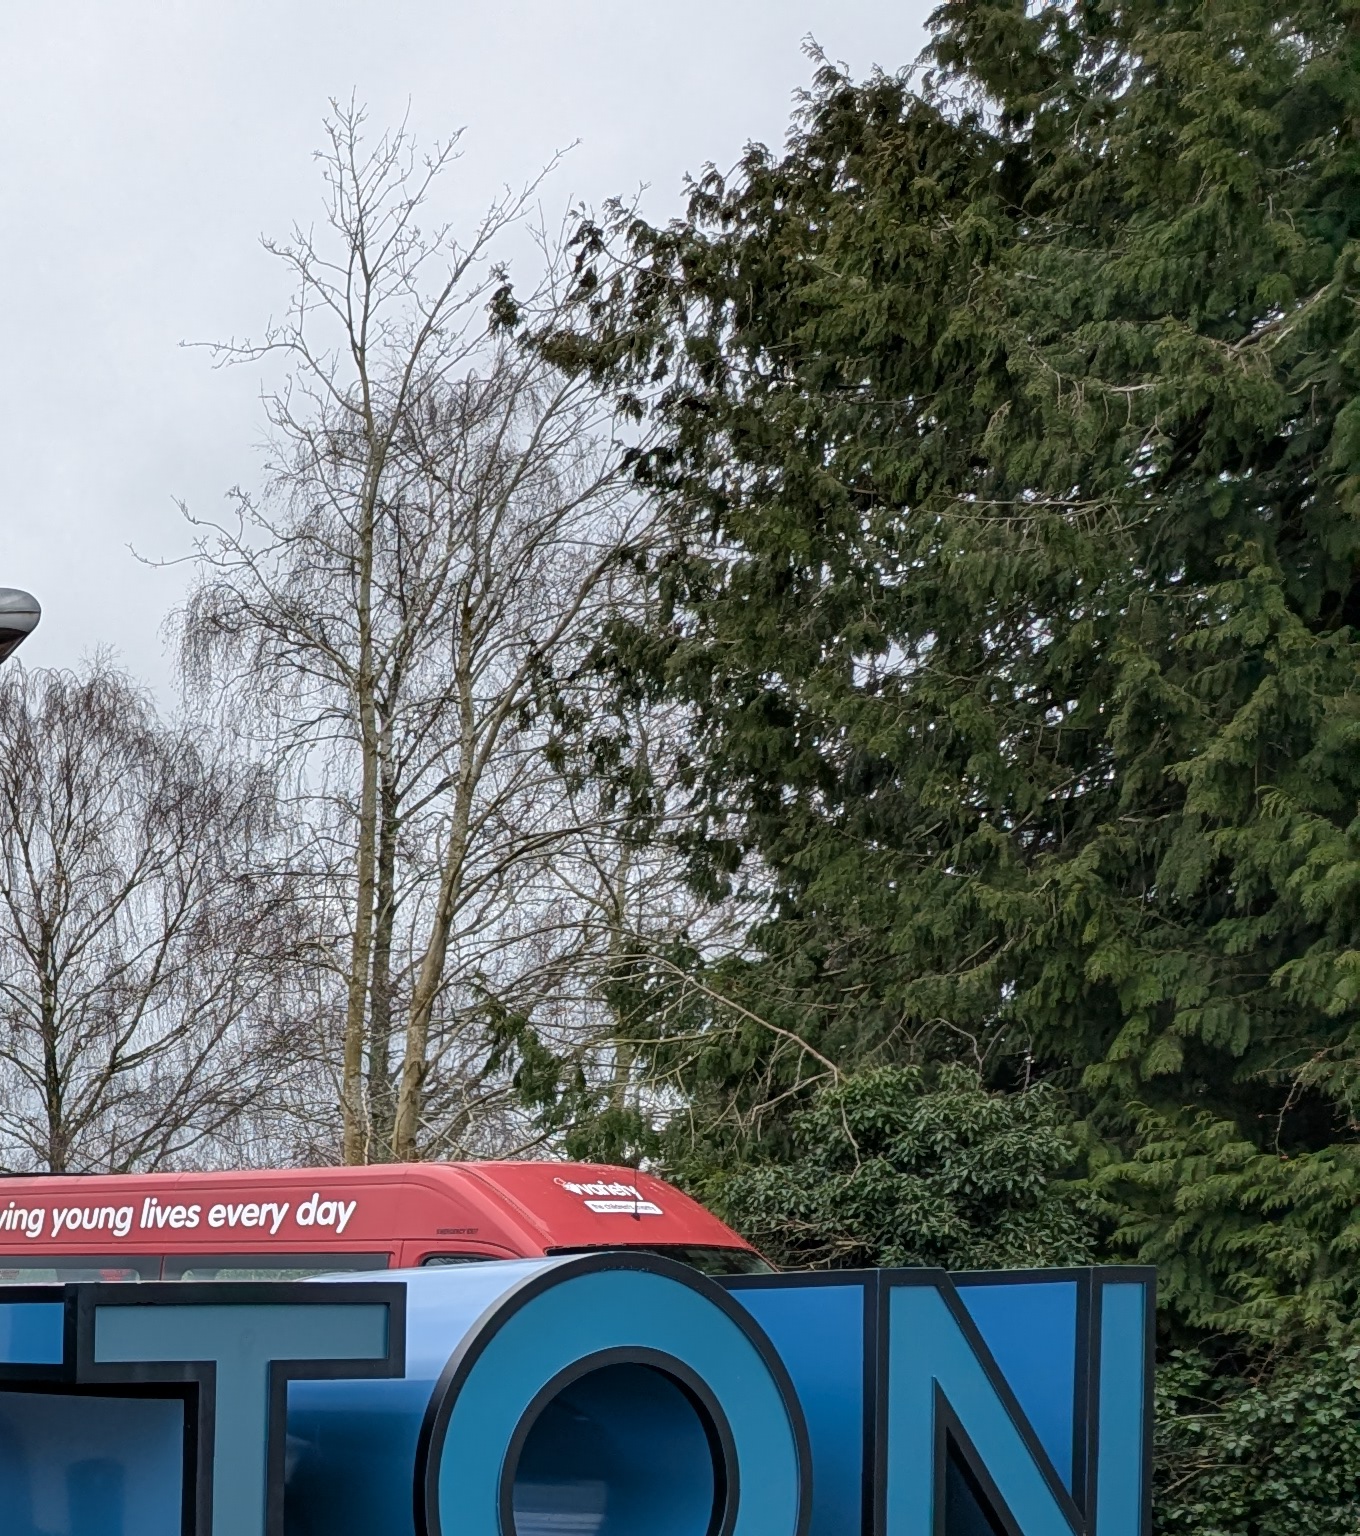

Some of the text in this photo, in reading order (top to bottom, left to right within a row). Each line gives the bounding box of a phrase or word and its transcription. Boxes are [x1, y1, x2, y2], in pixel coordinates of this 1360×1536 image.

[574, 1180, 644, 1201] variety
[52, 1205, 134, 1238] young
[139, 1197, 202, 1229] lives
[207, 1202, 290, 1235] every
[295, 1192, 357, 1234] day
